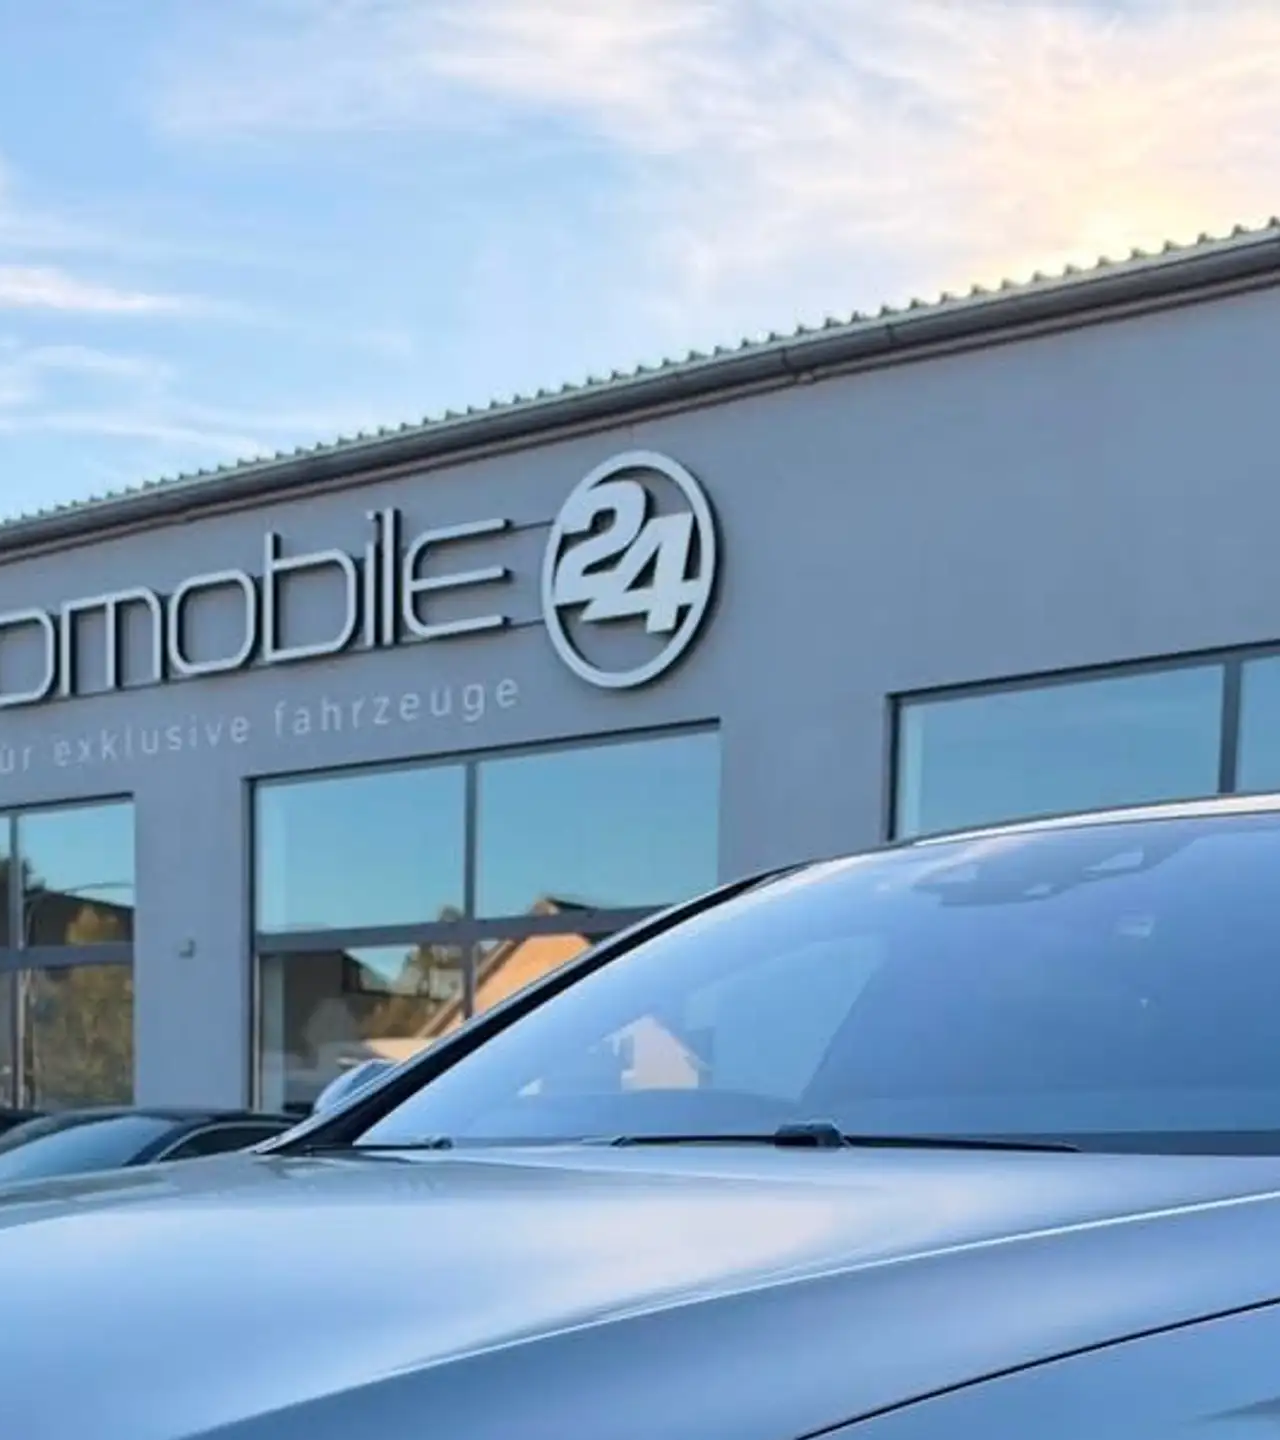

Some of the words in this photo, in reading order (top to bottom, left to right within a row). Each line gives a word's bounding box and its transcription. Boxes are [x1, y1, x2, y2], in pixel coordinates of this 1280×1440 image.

[553, 479, 703, 635] 24
[53, 712, 250, 768] exklusive
[272, 676, 520, 737] fahrzeuge
